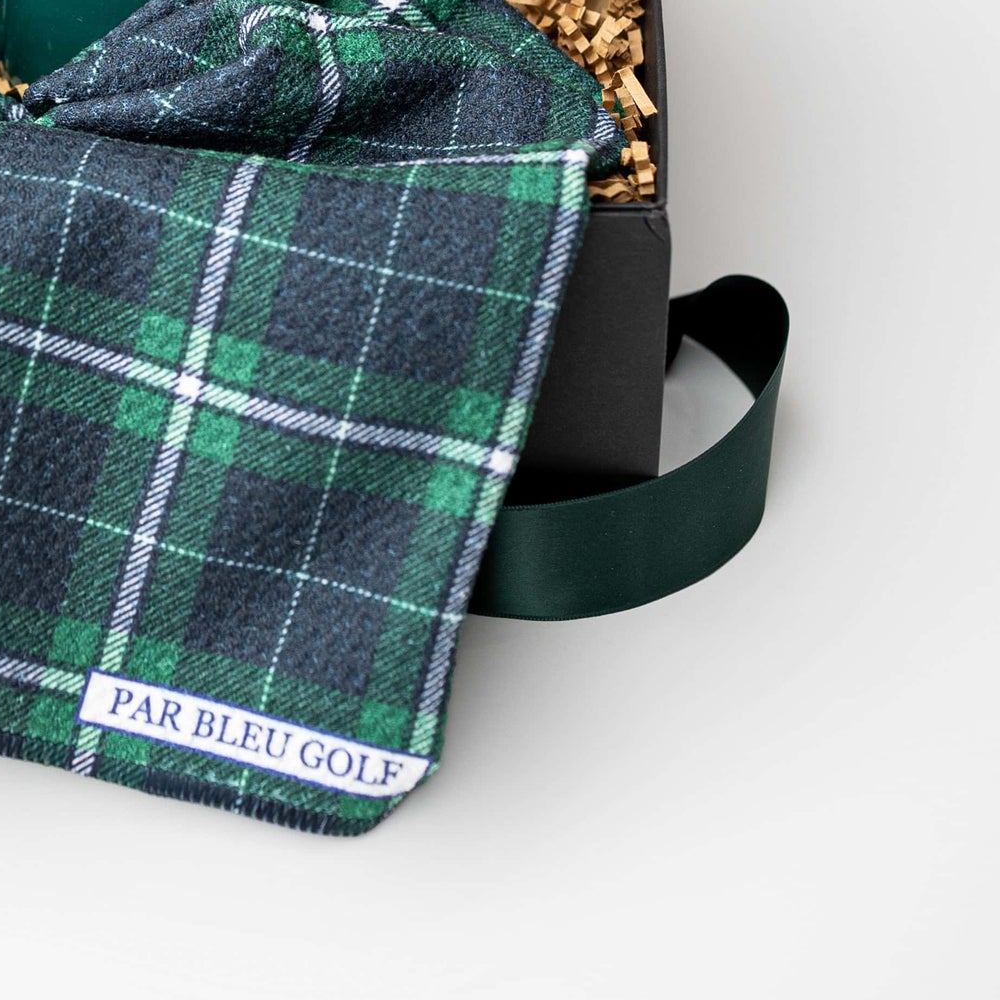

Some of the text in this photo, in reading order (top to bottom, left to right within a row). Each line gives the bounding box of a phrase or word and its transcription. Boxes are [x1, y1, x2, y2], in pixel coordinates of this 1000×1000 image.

[107, 687, 404, 787] PAR BLEU GOLF
